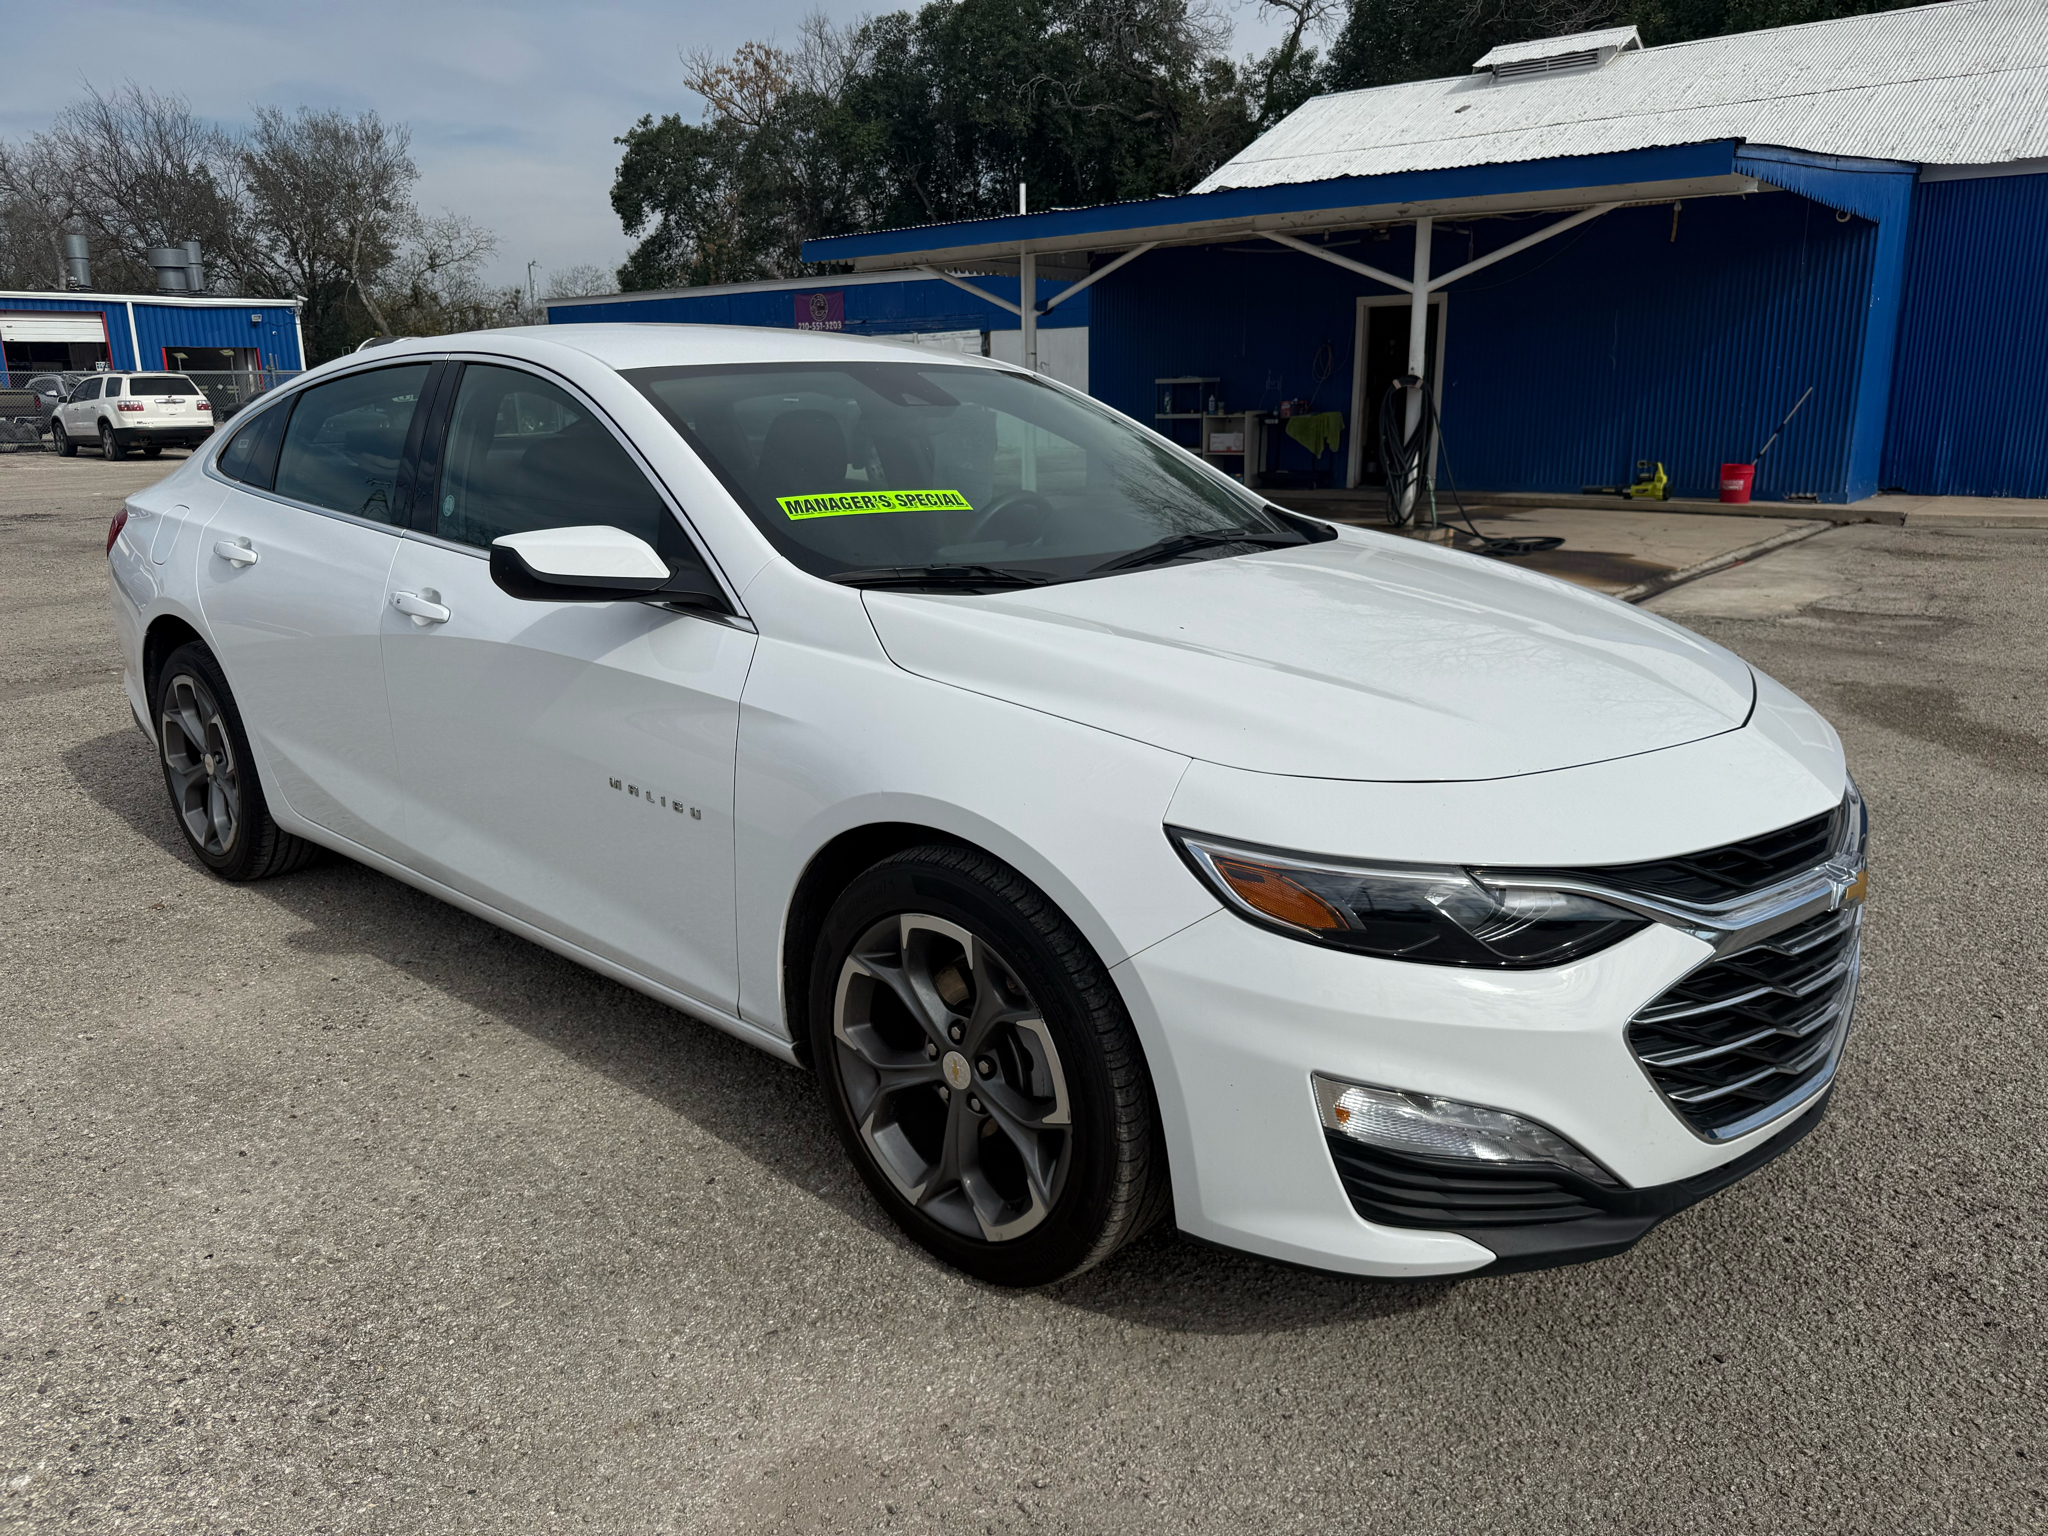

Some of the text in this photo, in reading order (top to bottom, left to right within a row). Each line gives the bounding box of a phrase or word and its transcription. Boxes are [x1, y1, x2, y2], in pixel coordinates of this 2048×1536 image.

[798, 321, 842, 330] 210-551-3203
[784, 493, 967, 516] MANAGER'S SPECIAL
[608, 776, 702, 820] MALIBU
